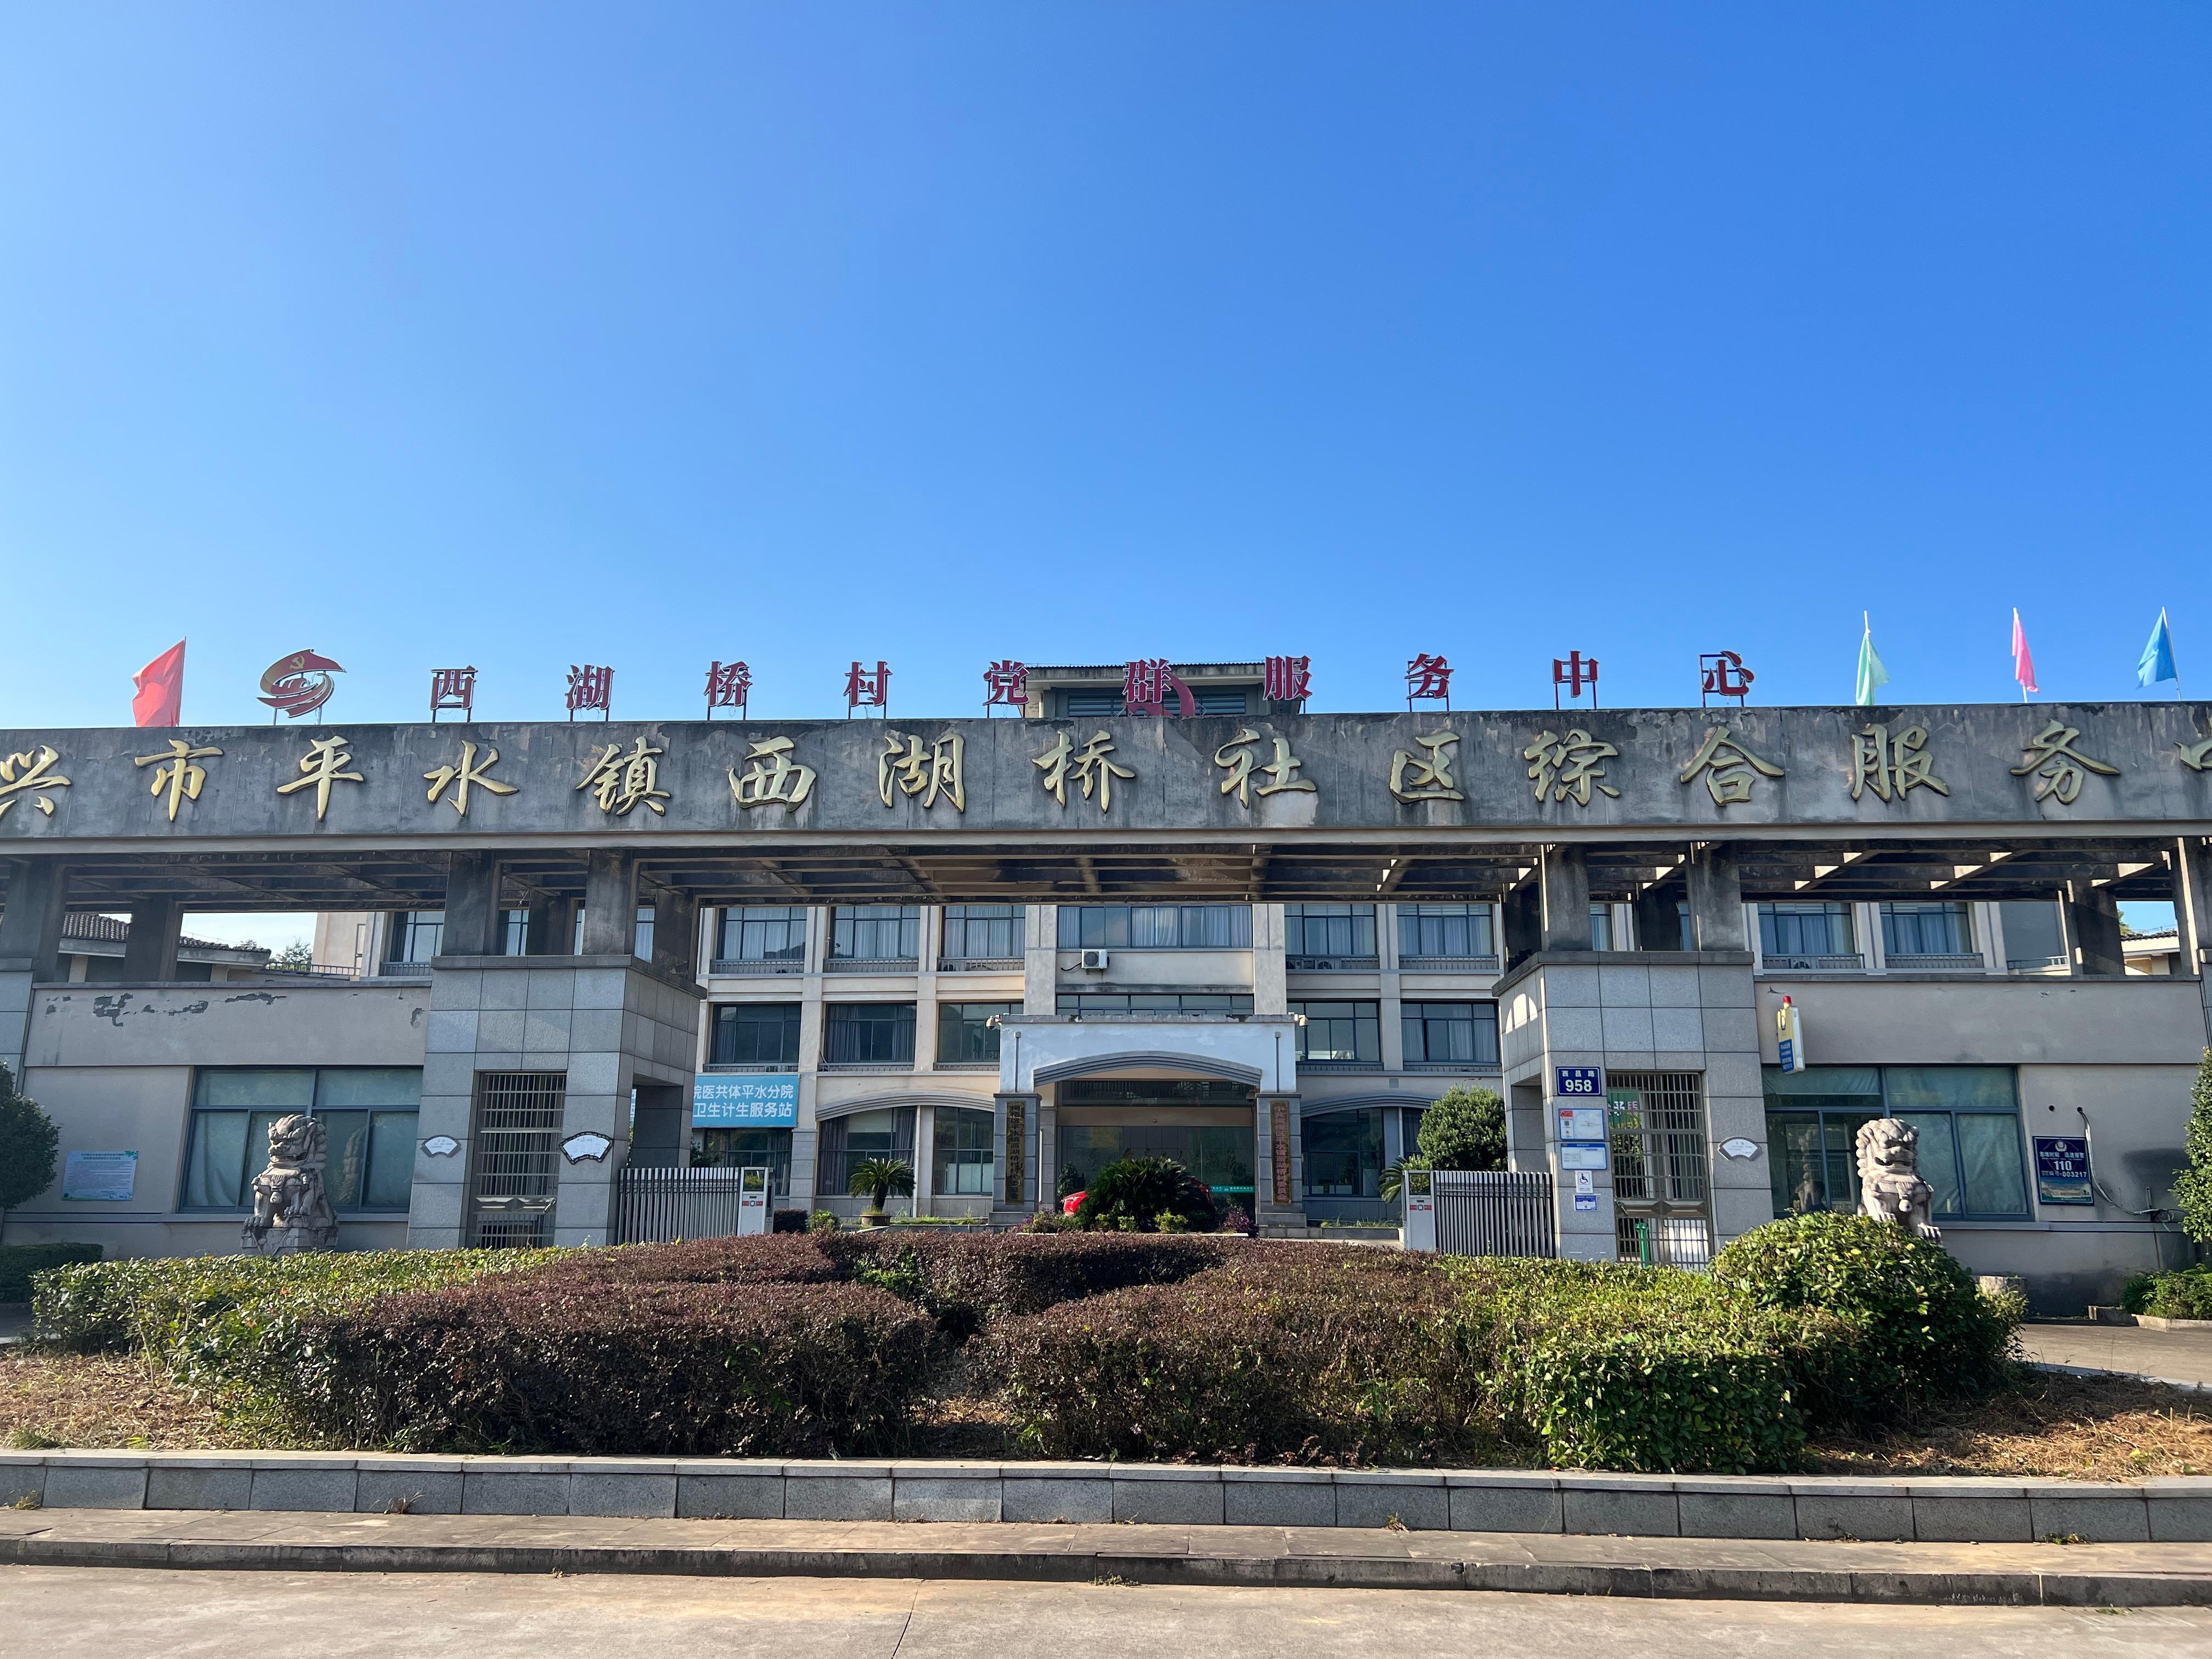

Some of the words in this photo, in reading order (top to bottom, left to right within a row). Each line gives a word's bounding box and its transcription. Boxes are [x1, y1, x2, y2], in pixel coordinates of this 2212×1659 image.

[430, 650, 1755, 711] 西湖桥村党群服务中心
[1565, 1079, 1592, 1092] 958
[693, 1102, 793, 1118] 卫生计生服务站
[2053, 1160, 2072, 1171] 110
